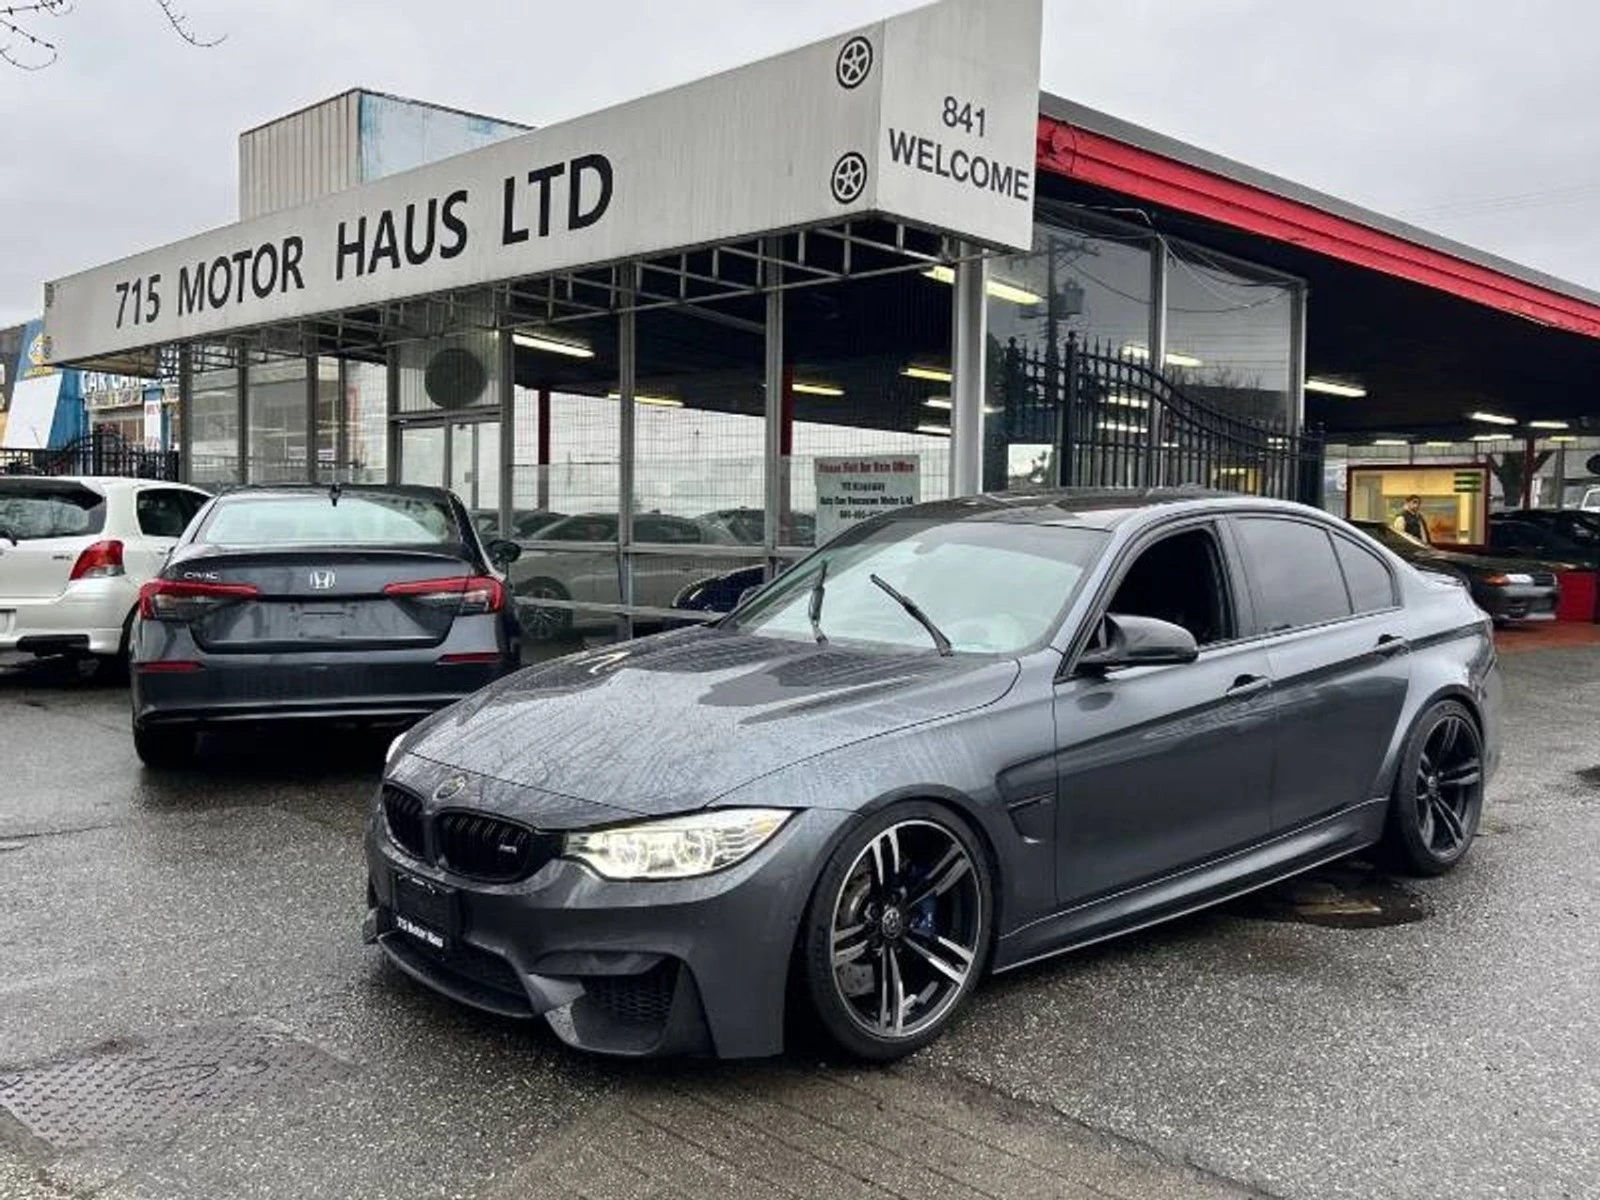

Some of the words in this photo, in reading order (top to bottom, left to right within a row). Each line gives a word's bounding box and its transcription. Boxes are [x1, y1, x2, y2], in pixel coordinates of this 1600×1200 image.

[943, 96, 985, 138] 841
[889, 128, 1030, 202] WELCOME
[116, 273, 162, 329] 715
[177, 235, 305, 318] MOTOR
[335, 189, 468, 281] HAUS
[502, 153, 613, 245] LTD
